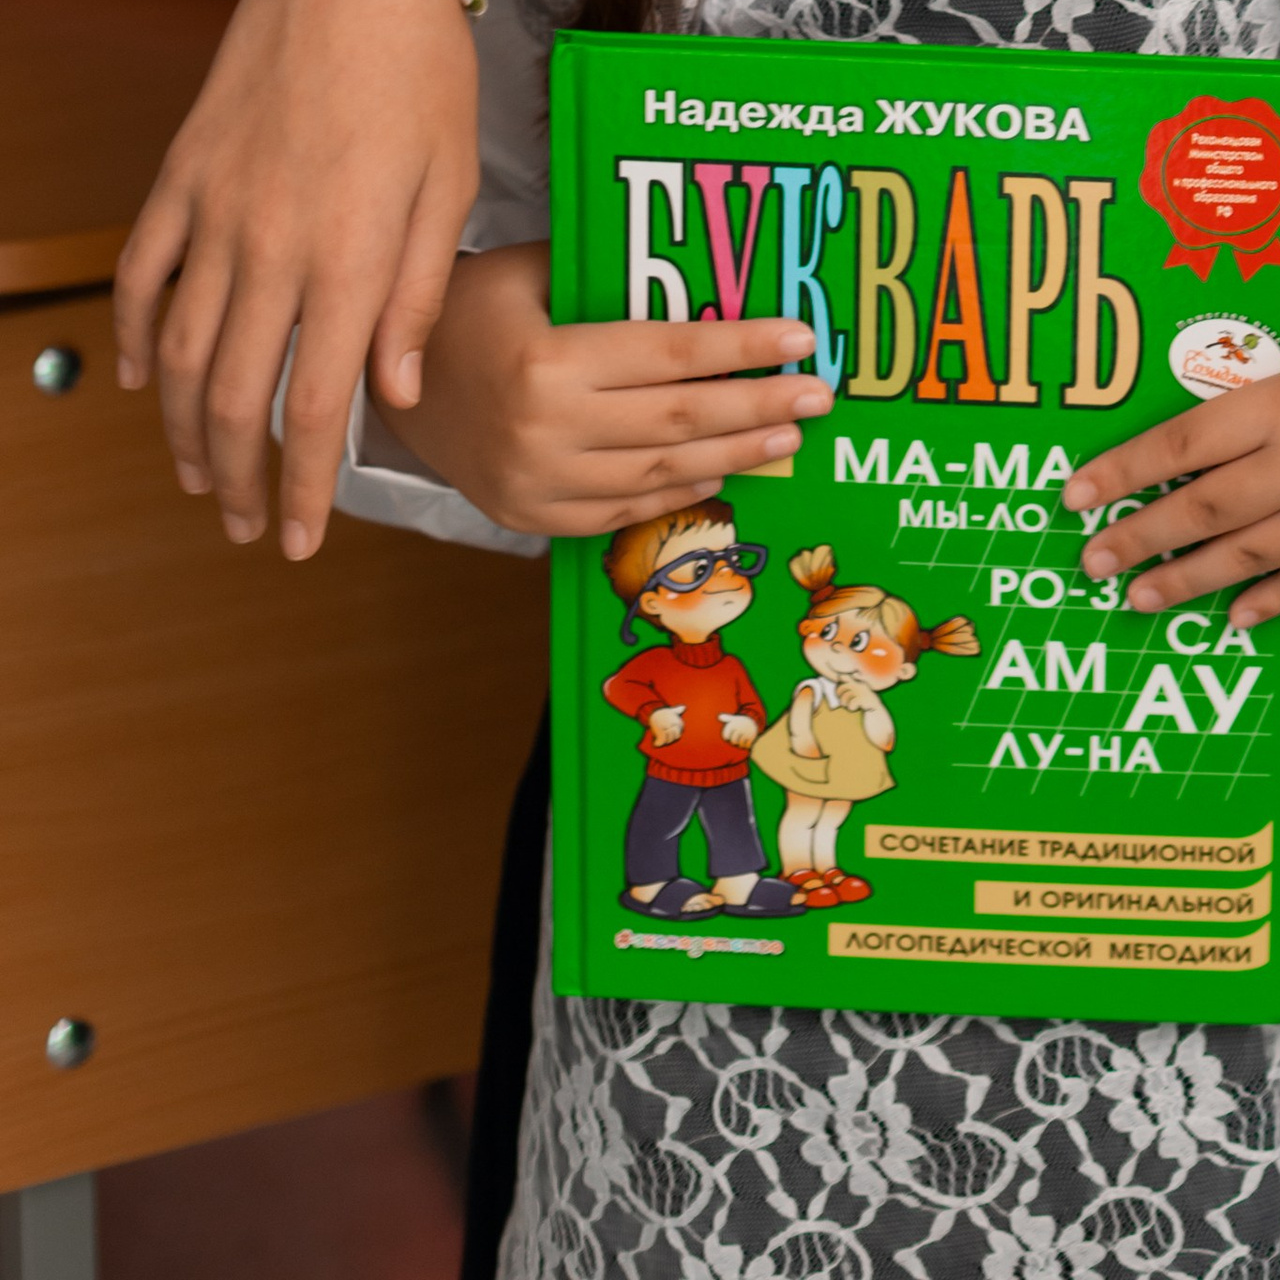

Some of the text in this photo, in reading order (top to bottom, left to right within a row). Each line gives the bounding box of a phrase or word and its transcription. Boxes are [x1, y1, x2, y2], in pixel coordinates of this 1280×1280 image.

[644, 89, 1091, 142] Надежда ЖУКОВА
[1216, 205, 1233, 218] РФ
[616, 156, 1142, 409] БУКВАРЬ
[834, 436, 1076, 490] МА-МА
[899, 499, 1049, 533] МЫ-ЛО
[990, 568, 1134, 611] РО-З
[1166, 612, 1257, 656] СА
[985, 639, 1107, 693] АМ
[1123, 663, 1263, 735] АУ
[989, 731, 1162, 774] ЛУ-НА
[879, 833, 1256, 864] СОЧЕТАНИЕ ТРАДИЦИОННОЙ
[1013, 890, 1254, 915] И ОРИГИНАЛЬНОЙ
[845, 932, 1252, 964] ЛОГОПЕДИЧЕСКОЙ МЕТОДИКИ
